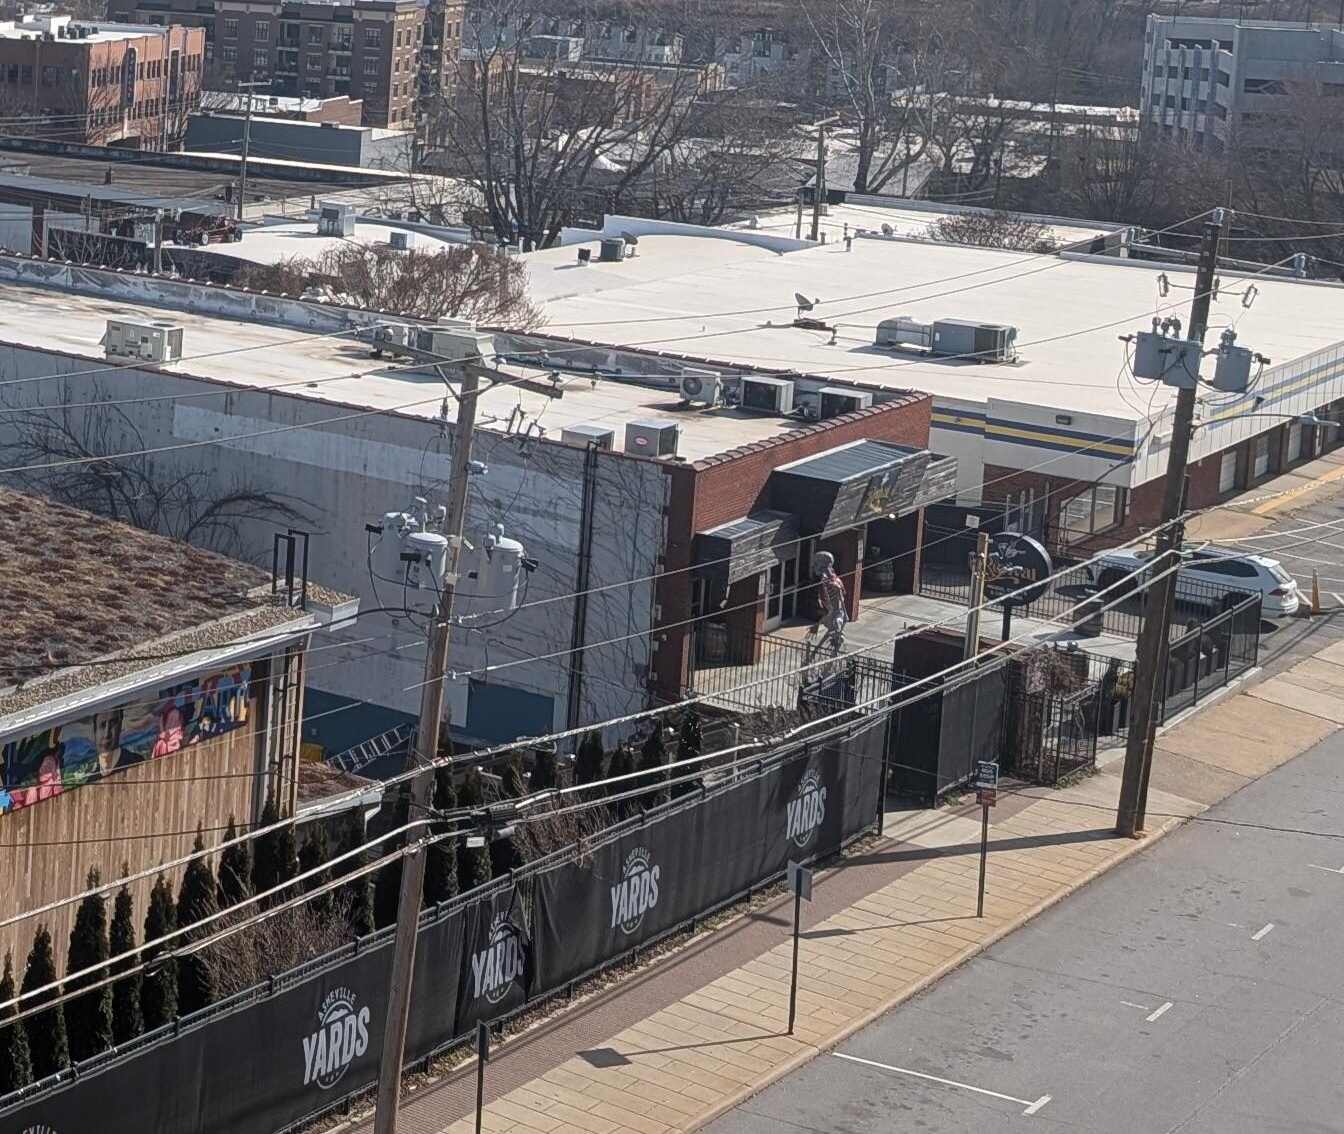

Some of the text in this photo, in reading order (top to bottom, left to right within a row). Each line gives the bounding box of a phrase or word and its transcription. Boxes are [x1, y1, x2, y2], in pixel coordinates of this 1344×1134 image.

[785, 786, 827, 841] YARDS
[622, 846, 651, 875] ASHEVILLE
[610, 864, 660, 929] YARDS
[317, 986, 357, 1022] ASHEVILLE
[302, 1005, 371, 1086] YARDS
